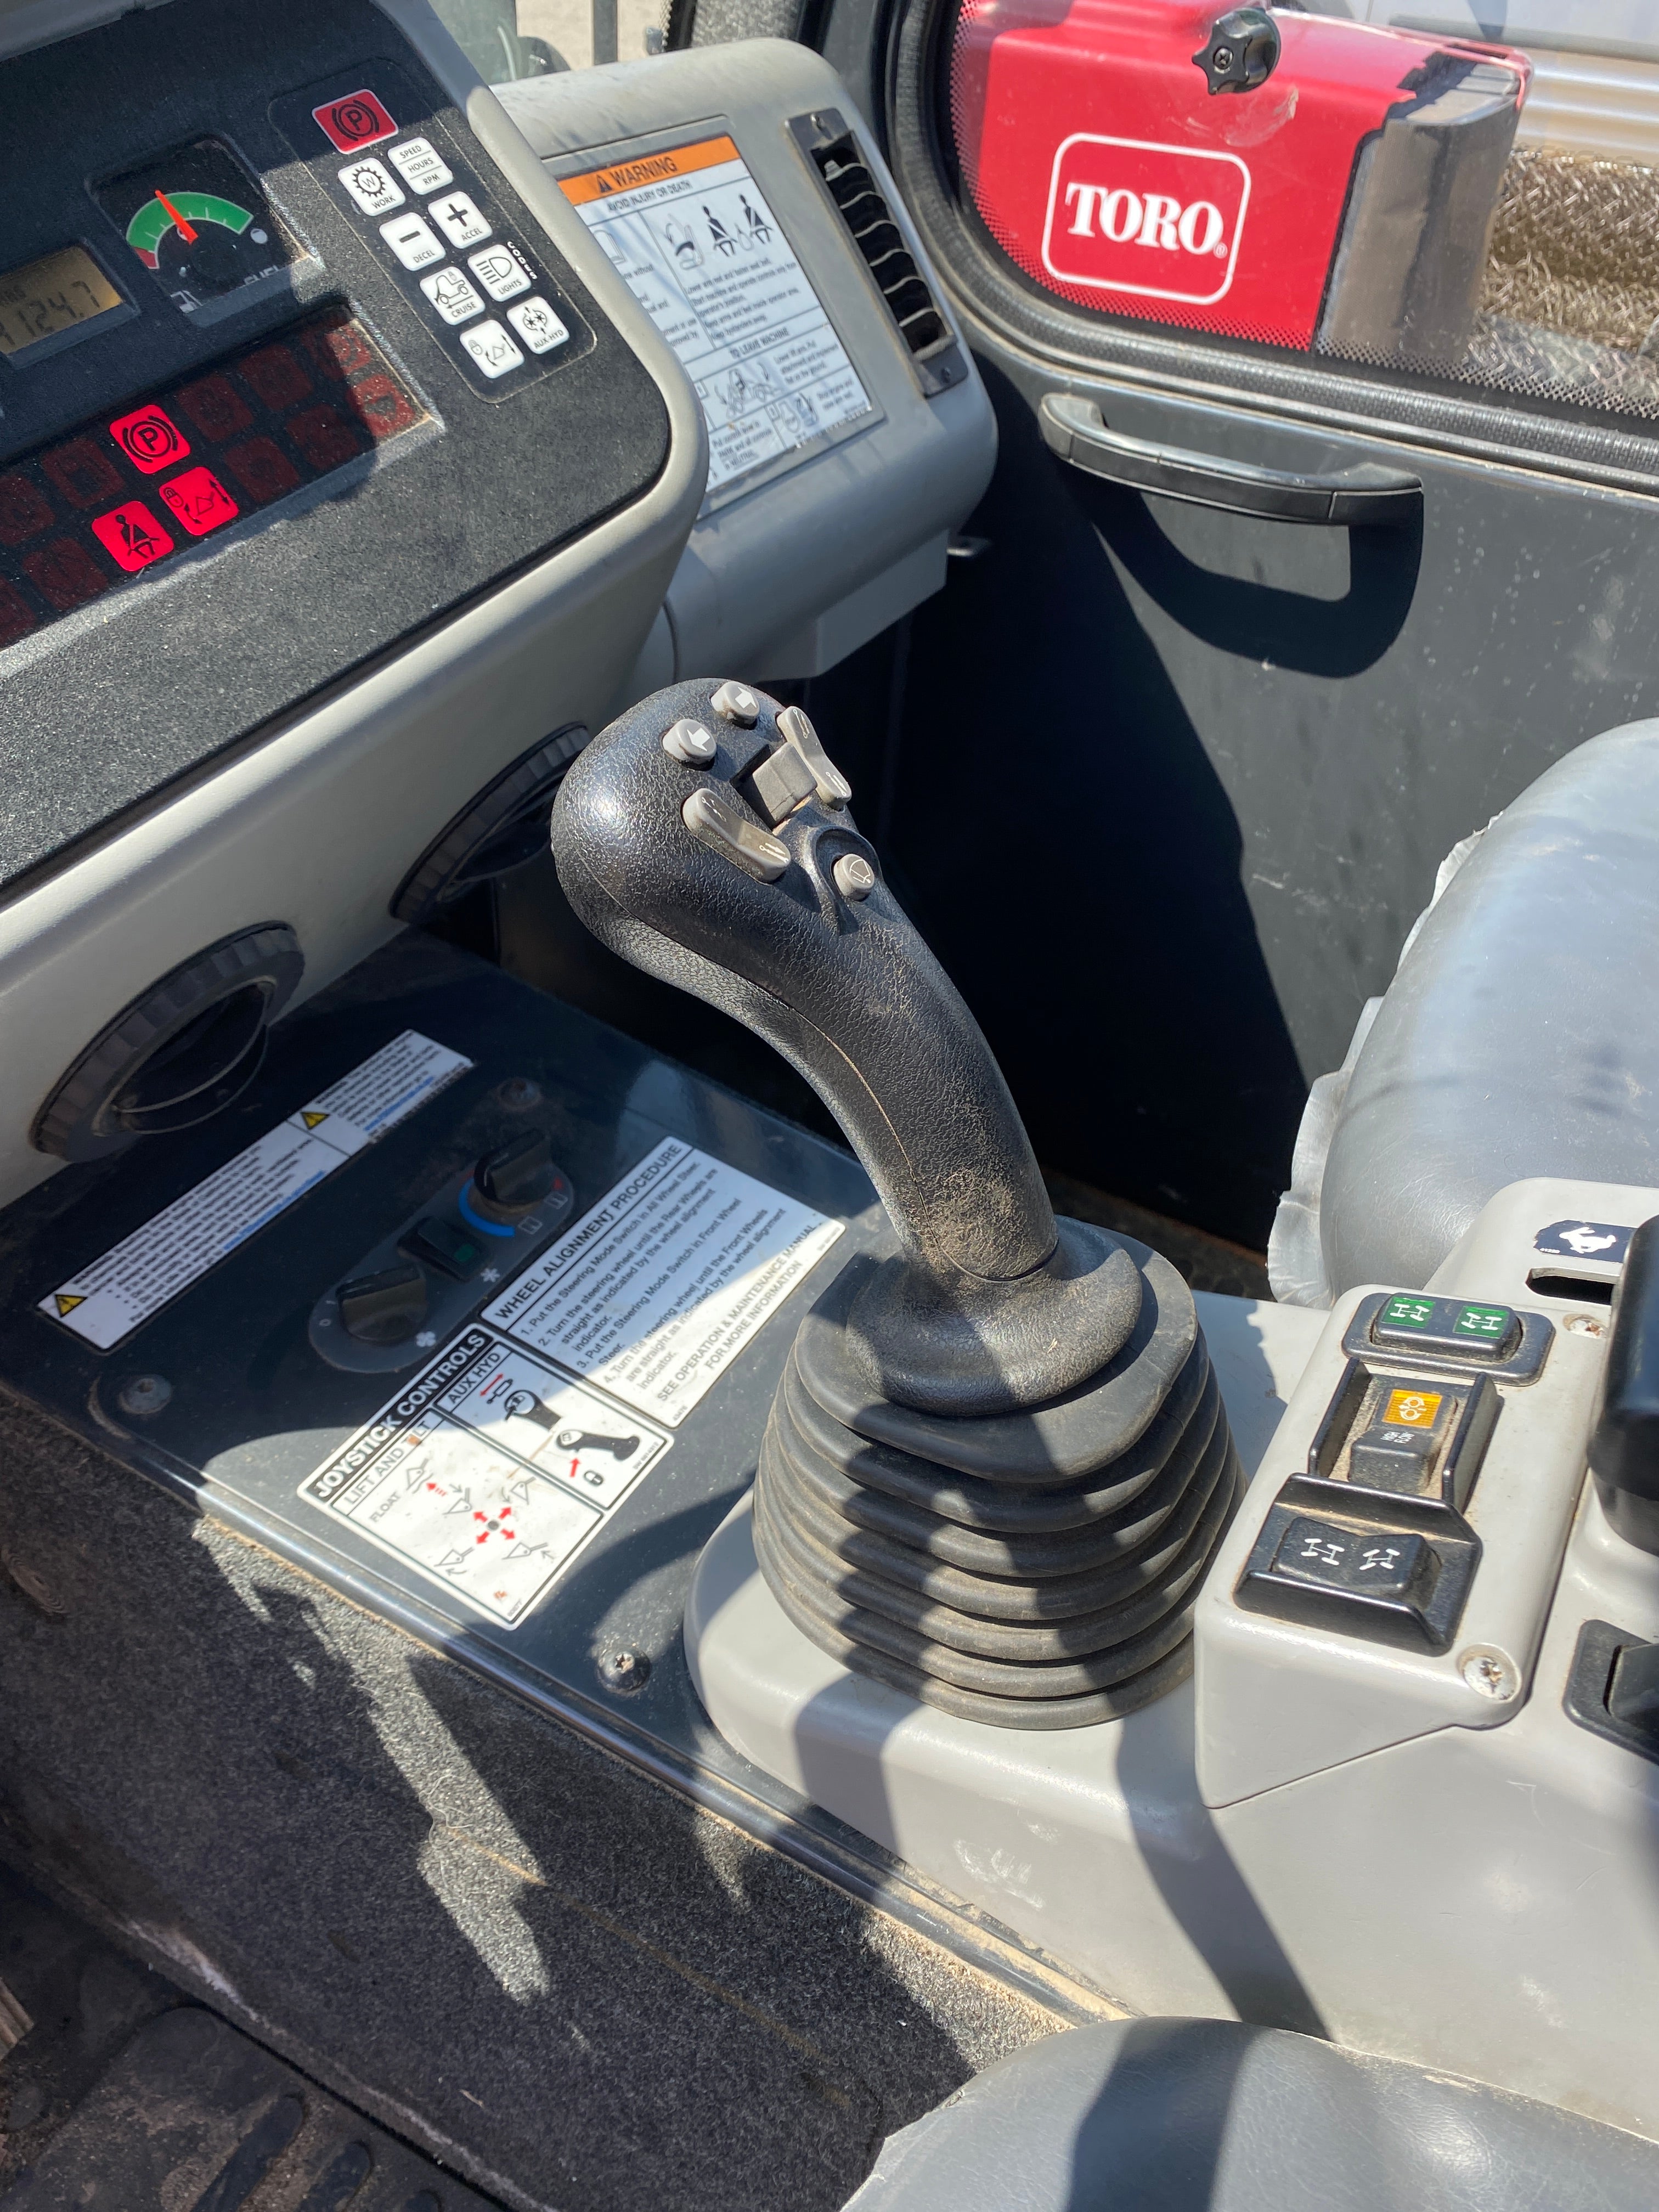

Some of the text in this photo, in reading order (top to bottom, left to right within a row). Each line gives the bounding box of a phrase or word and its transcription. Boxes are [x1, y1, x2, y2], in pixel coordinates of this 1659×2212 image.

[399, 145, 421, 159] SPEED
[408, 157, 433, 172] HOURS
[609, 156, 678, 187] WARNING
[422, 173, 440, 185] RPM
[371, 195, 396, 208] WORK
[1065, 182, 1224, 255] TORO
[461, 228, 483, 241] ACCEL
[413, 250, 435, 263] DECEL
[507, 241, 538, 280] CODES
[498, 279, 523, 294] LIGHTS
[452, 302, 476, 317] CRUISE
[534, 329, 563, 349] AUX HYD
[495, 1144, 682, 1320] WHEEL ALIGNMENT PROCEDURE
[520, 1160, 701, 1336] 1. Put the Steering Mode Switch in All Wheel Steer.
[538, 1336, 551, 1346] 2.
[565, 1303, 584, 1319] the
[579, 1272, 617, 1306] steering
[610, 1249, 637, 1273] wheel
[633, 1233, 653, 1251] until
[648, 1221, 665, 1235] the
[662, 1204, 682, 1222] Rear
[678, 1179, 707, 1205] Wheels
[704, 1169, 719, 1180] are
[559, 1188, 718, 1346] straight as indicated by the wheel alignment
[576, 1198, 742, 1368] 3. Put the Steering Mode Switch in Front Wheel
[625, 1207, 788, 1382] are straight as indicated by the wheel alignment
[629, 1339, 647, 1355] the
[642, 1307, 679, 1341] steering
[672, 1283, 699, 1308] wheel
[694, 1266, 715, 1284] until
[709, 1253, 726, 1267] the
[722, 1234, 744, 1254] Front
[740, 1208, 768, 1235] Wheels
[572, 1313, 613, 1352] indicator.
[656, 1223, 816, 1402] SEE OPERATION & MAINTENANCE MANUAL
[704, 1260, 803, 1369] FOR MORE INFORMATION
[597, 1340, 626, 1367] Steer.
[637, 1349, 678, 1390] indicator.
[445, 1351, 501, 1403] AUX HYD
[310, 1333, 487, 1499] JOYSTICK CONTROLS
[343, 1475, 377, 1505] LIFT
[374, 1447, 405, 1475] AND
[369, 1491, 402, 1522] FLOAT
